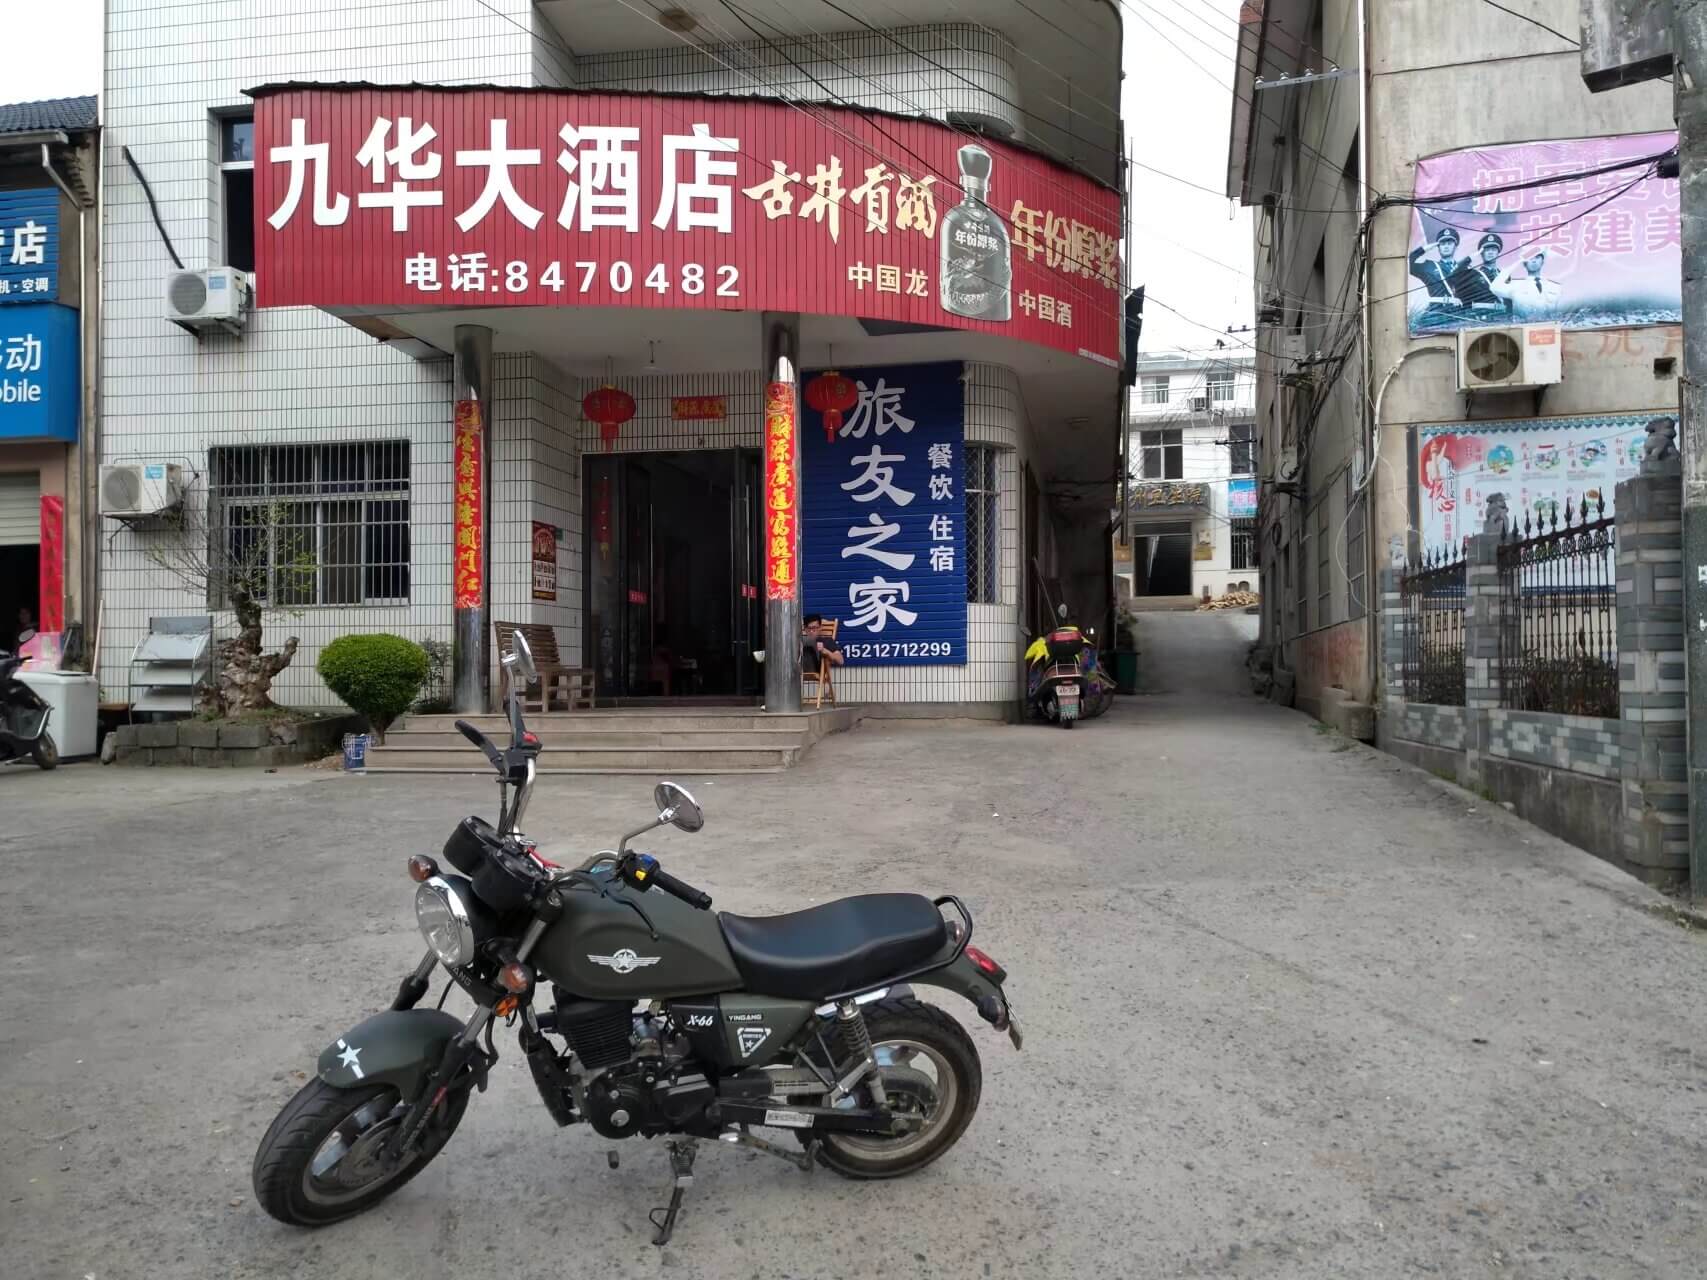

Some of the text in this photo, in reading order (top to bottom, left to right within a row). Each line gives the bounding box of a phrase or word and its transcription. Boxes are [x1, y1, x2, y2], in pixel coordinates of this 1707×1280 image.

[266, 116, 740, 234] 九华大酒店
[0, 220, 48, 265] 店
[1010, 199, 1119, 290] 年份原浆
[848, 261, 929, 297] 中国龙
[1018, 289, 1073, 328] 中国酒
[0, 333, 42, 373] 动
[0, 379, 42, 403] bile
[839, 377, 918, 633] 旅友之家
[843, 642, 951, 658] 15212712299
[686, 1015, 714, 1027] X-66
